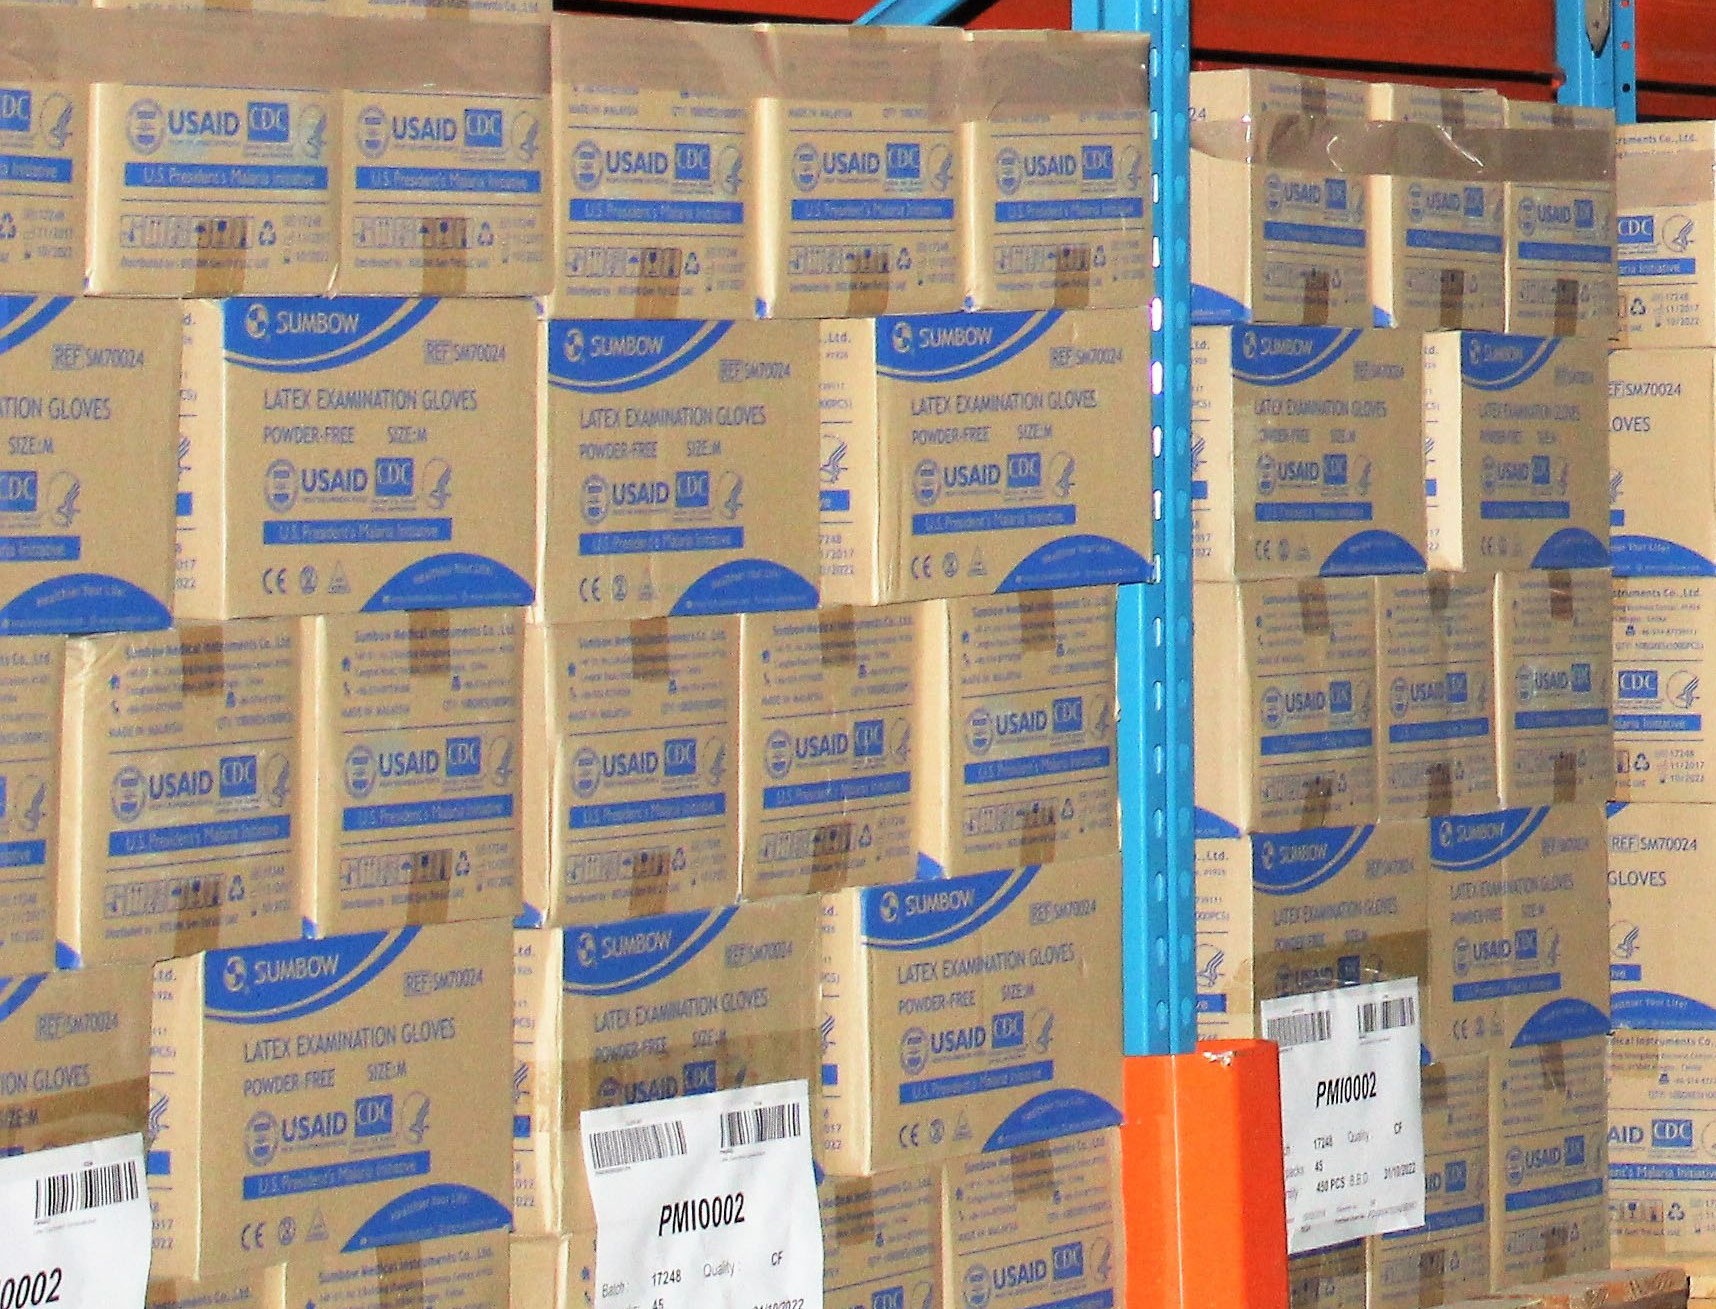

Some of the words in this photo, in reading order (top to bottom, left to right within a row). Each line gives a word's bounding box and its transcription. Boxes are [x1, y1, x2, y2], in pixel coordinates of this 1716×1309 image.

[167, 111, 241, 138] USAID
[248, 103, 289, 132] CDC
[392, 115, 457, 143] USAID
[605, 150, 669, 177] USAID
[822, 152, 881, 177] USAID
[1025, 154, 1077, 179] USAID
[1618, 218, 1655, 237] CDC
[276, 312, 360, 336] SUMBOW
[920, 326, 993, 349] SUMBOW
[591, 335, 664, 358] SUMBOW
[263, 390, 311, 413] LATEX
[317, 389, 420, 412] EXAMINATION
[423, 389, 478, 412] GLOVES
[911, 394, 950, 417] LATEX
[955, 392, 1044, 416] EXAMINATION
[1048, 390, 1098, 411] GLOVES
[1626, 383, 1682, 398] SM70024
[580, 407, 620, 429] LATEX
[626, 405, 712, 429] EXAMINATION
[717, 404, 767, 427] GLOVES
[263, 426, 356, 447] POWDER-FREE
[301, 468, 369, 493] USAID
[943, 464, 1001, 491] USAID
[612, 480, 670, 505] USAID
[1619, 672, 1656, 694] CDC
[996, 706, 1048, 738] USAID
[796, 729, 850, 761] USAID
[377, 748, 440, 781] USAID
[602, 748, 660, 780] USAID
[149, 768, 215, 802] USAID
[1612, 836, 1636, 852] REF
[1640, 836, 1698, 853] SM70024
[1606, 870, 1667, 887] GLOVES
[906, 888, 976, 915] SUMBOW
[601, 930, 673, 961] SUMBOW
[254, 953, 340, 986] SUMBOW
[897, 962, 937, 988] LATEX
[942, 952, 1025, 982] EXAMINATION
[1029, 942, 1076, 971] GLOVES
[243, 1037, 291, 1064] LATEX
[296, 1027, 396, 1059] EXAMINATION
[401, 1016, 456, 1045] GLOVES
[931, 1027, 987, 1057] USAID
[1316, 1071, 1377, 1109] PMI0002
[281, 1110, 348, 1144] USAID
[355, 1097, 393, 1126] CDC
[1653, 1121, 1692, 1141] CDC
[658, 1191, 746, 1238] PMI0002
[651, 1268, 682, 1288] 17248
[703, 1260, 736, 1279] Quality
[771, 1250, 784, 1267] CF
